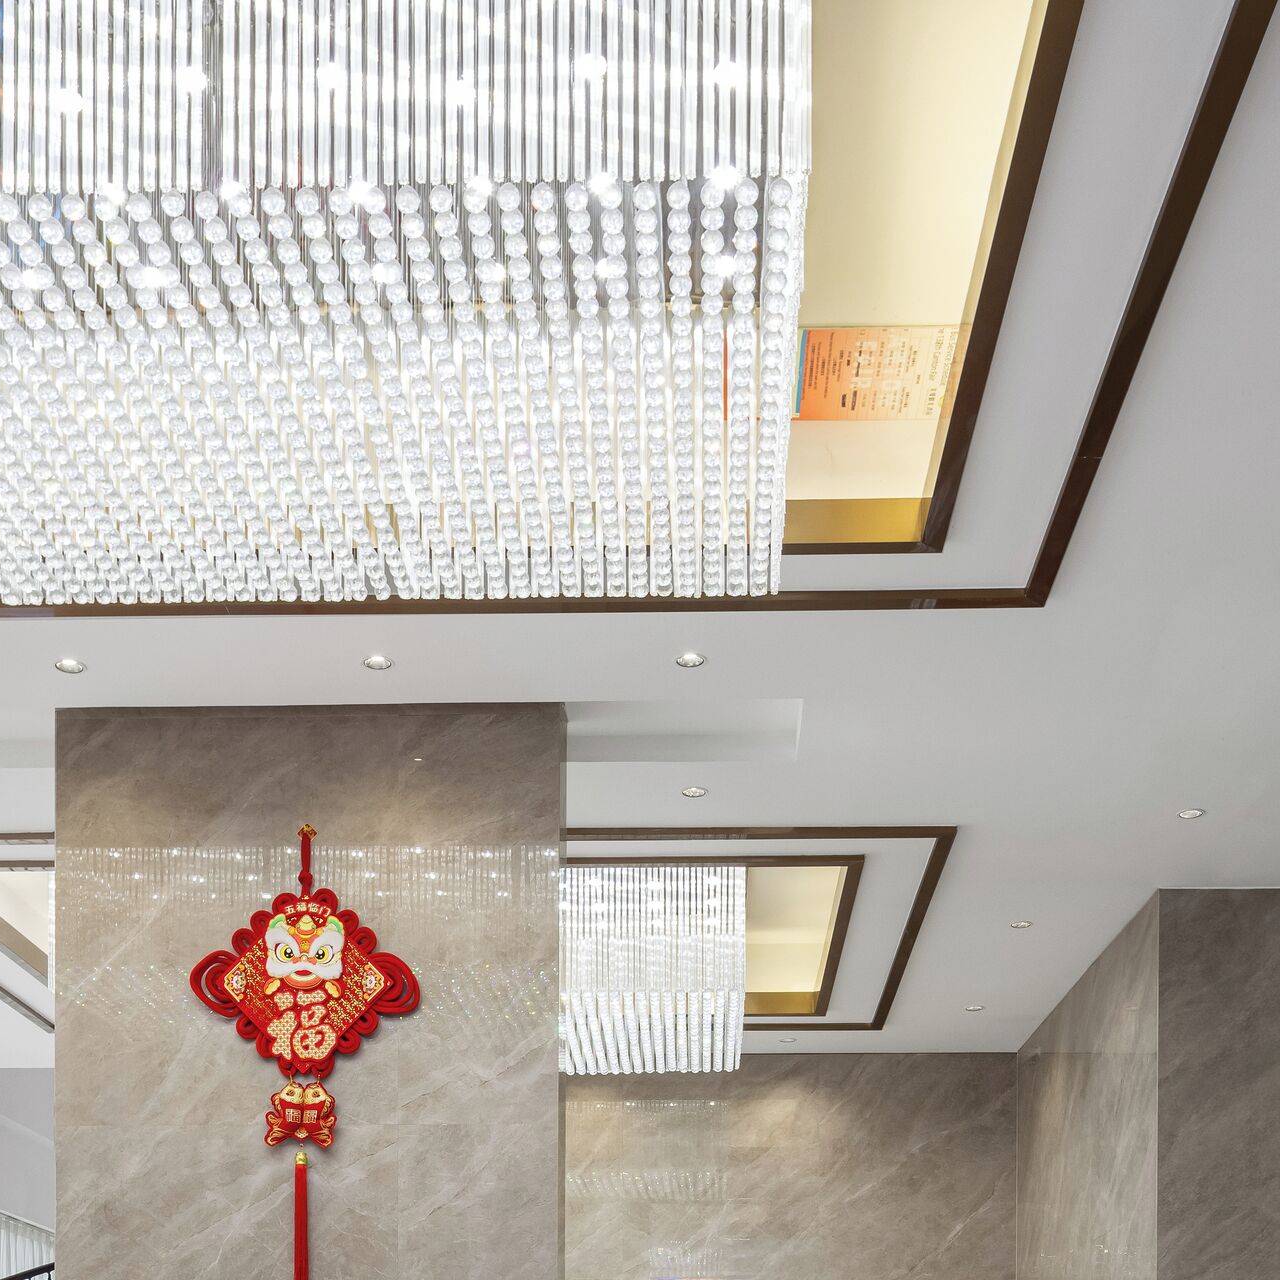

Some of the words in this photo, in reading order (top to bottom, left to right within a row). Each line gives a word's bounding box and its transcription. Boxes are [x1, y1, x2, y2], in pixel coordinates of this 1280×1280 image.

[284, 902, 332, 917] 五福临门
[266, 990, 338, 1061] 福
